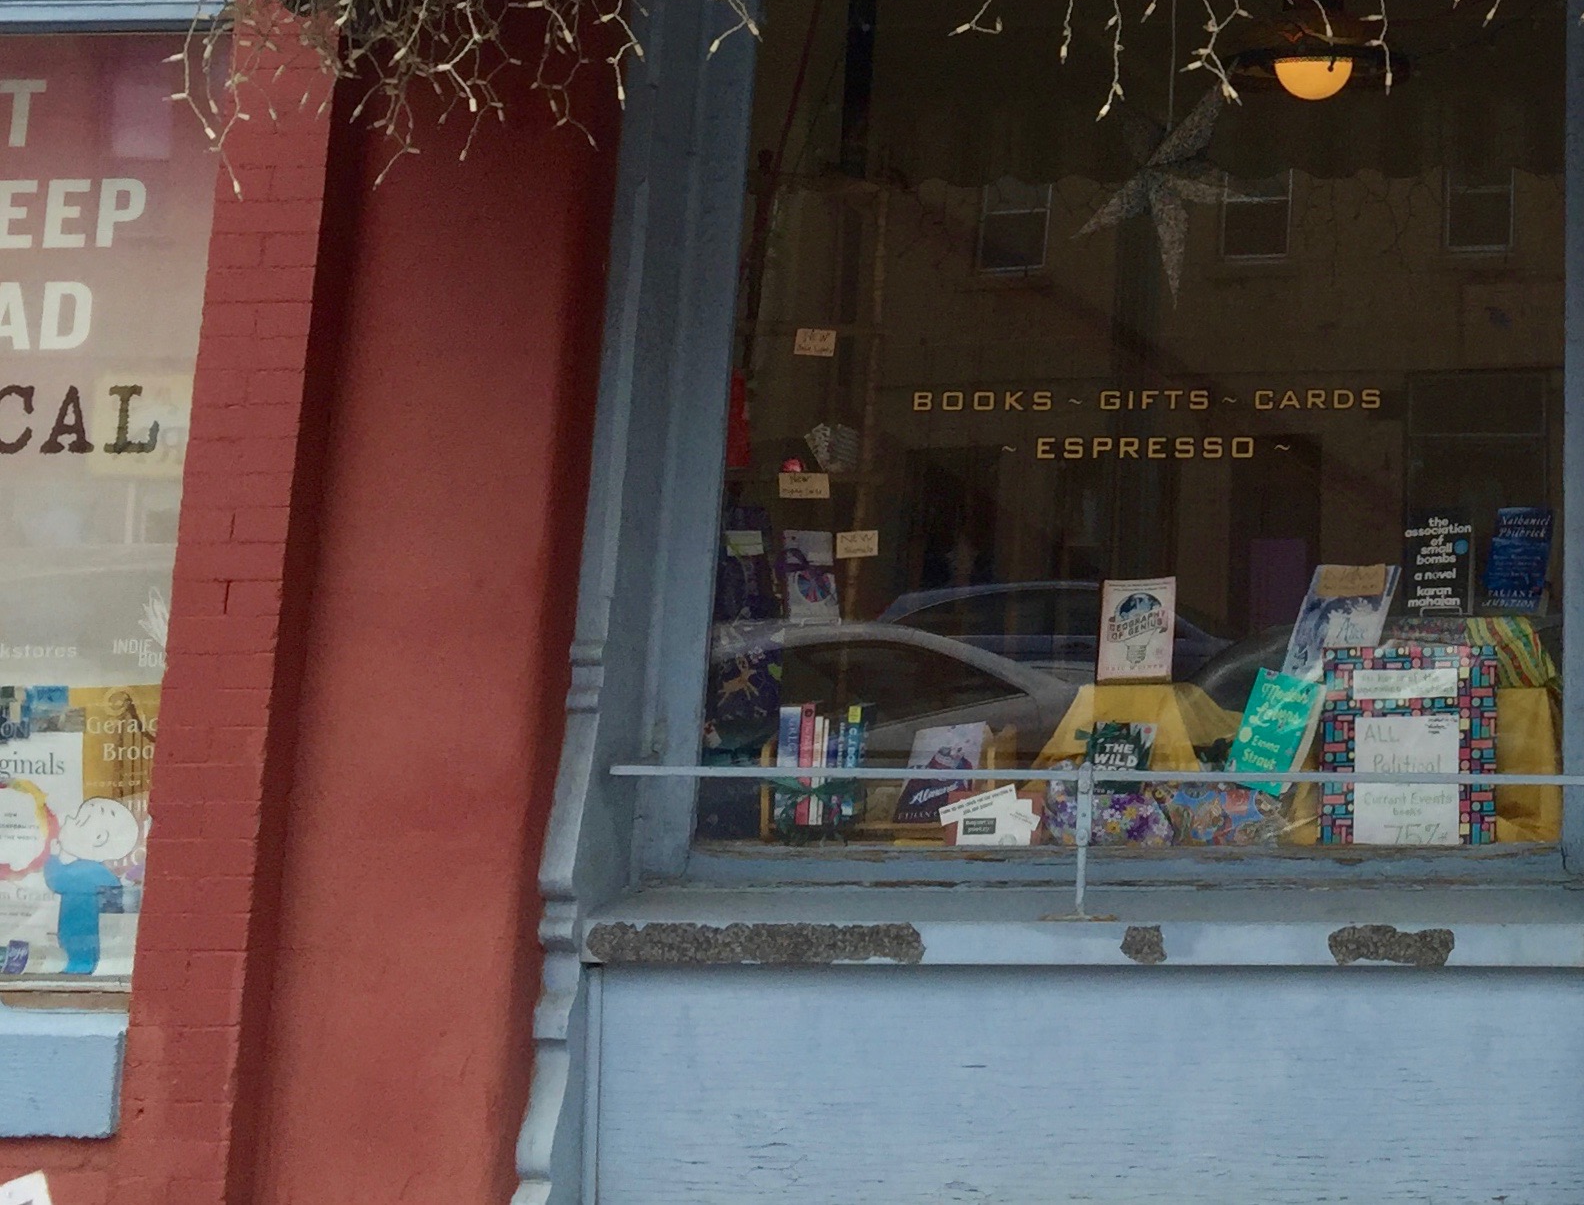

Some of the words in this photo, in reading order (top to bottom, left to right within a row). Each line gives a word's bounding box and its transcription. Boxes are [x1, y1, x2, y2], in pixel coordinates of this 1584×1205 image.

[912, 390, 1053, 412] BOOKS
[1099, 389, 1210, 411] GIFTS
[1254, 388, 1382, 410] CARDS
[1036, 436, 1255, 460] ESPRESSO
[1428, 516, 1449, 528] the
[1501, 514, 1551, 526] Nathaniel
[1404, 523, 1472, 538] association
[1430, 535, 1444, 546] of
[1420, 542, 1453, 555] small
[1416, 554, 1457, 566] bombs
[1414, 572, 1423, 581] a
[1424, 568, 1457, 580] novel
[1417, 586, 1452, 596] karan
[1408, 596, 1461, 607] mahajan
[1363, 724, 1401, 743] ALL
[1104, 743, 1135, 754] THE
[1250, 734, 1281, 753] Emma
[1094, 753, 1139, 767] WILD
[1372, 752, 1442, 774] Political
